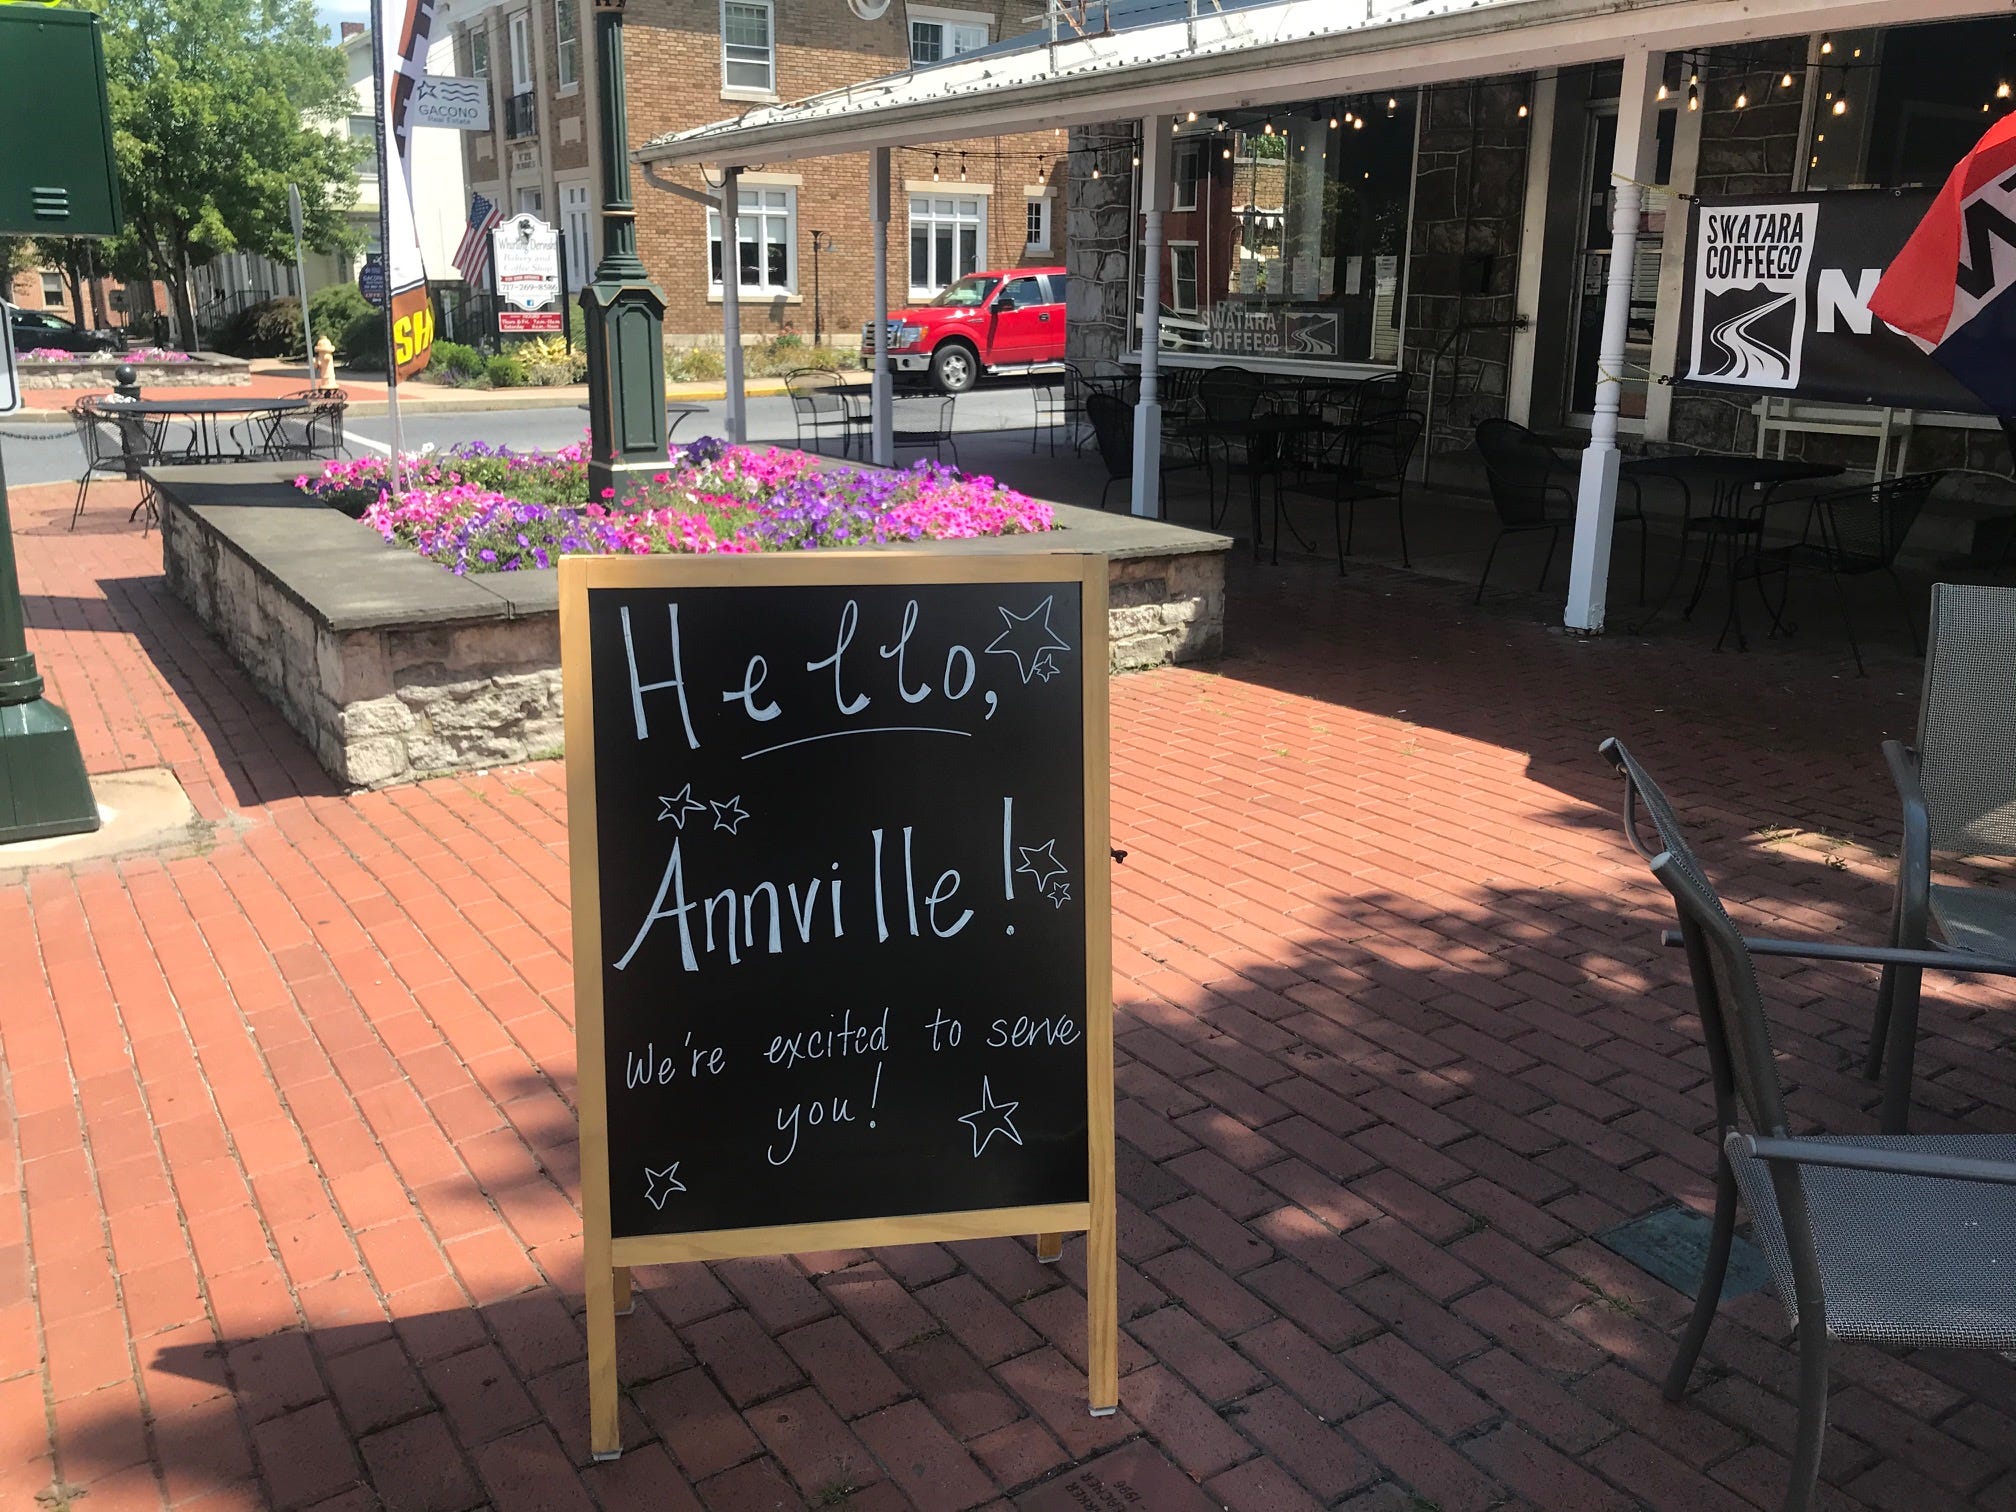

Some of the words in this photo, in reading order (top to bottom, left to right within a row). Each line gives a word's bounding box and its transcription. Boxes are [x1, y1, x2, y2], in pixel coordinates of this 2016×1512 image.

[418, 104, 478, 119] GACONO
[1706, 212, 1803, 244] SWATARA
[1201, 310, 1277, 331] SWATARA
[619, 599, 998, 749] Hello,
[625, 1031, 727, 1090] We're
[763, 1007, 890, 1069] excited
[925, 1008, 962, 1053] to
[986, 1013, 1081, 1049] serve
[767, 1061, 883, 1166] you!
